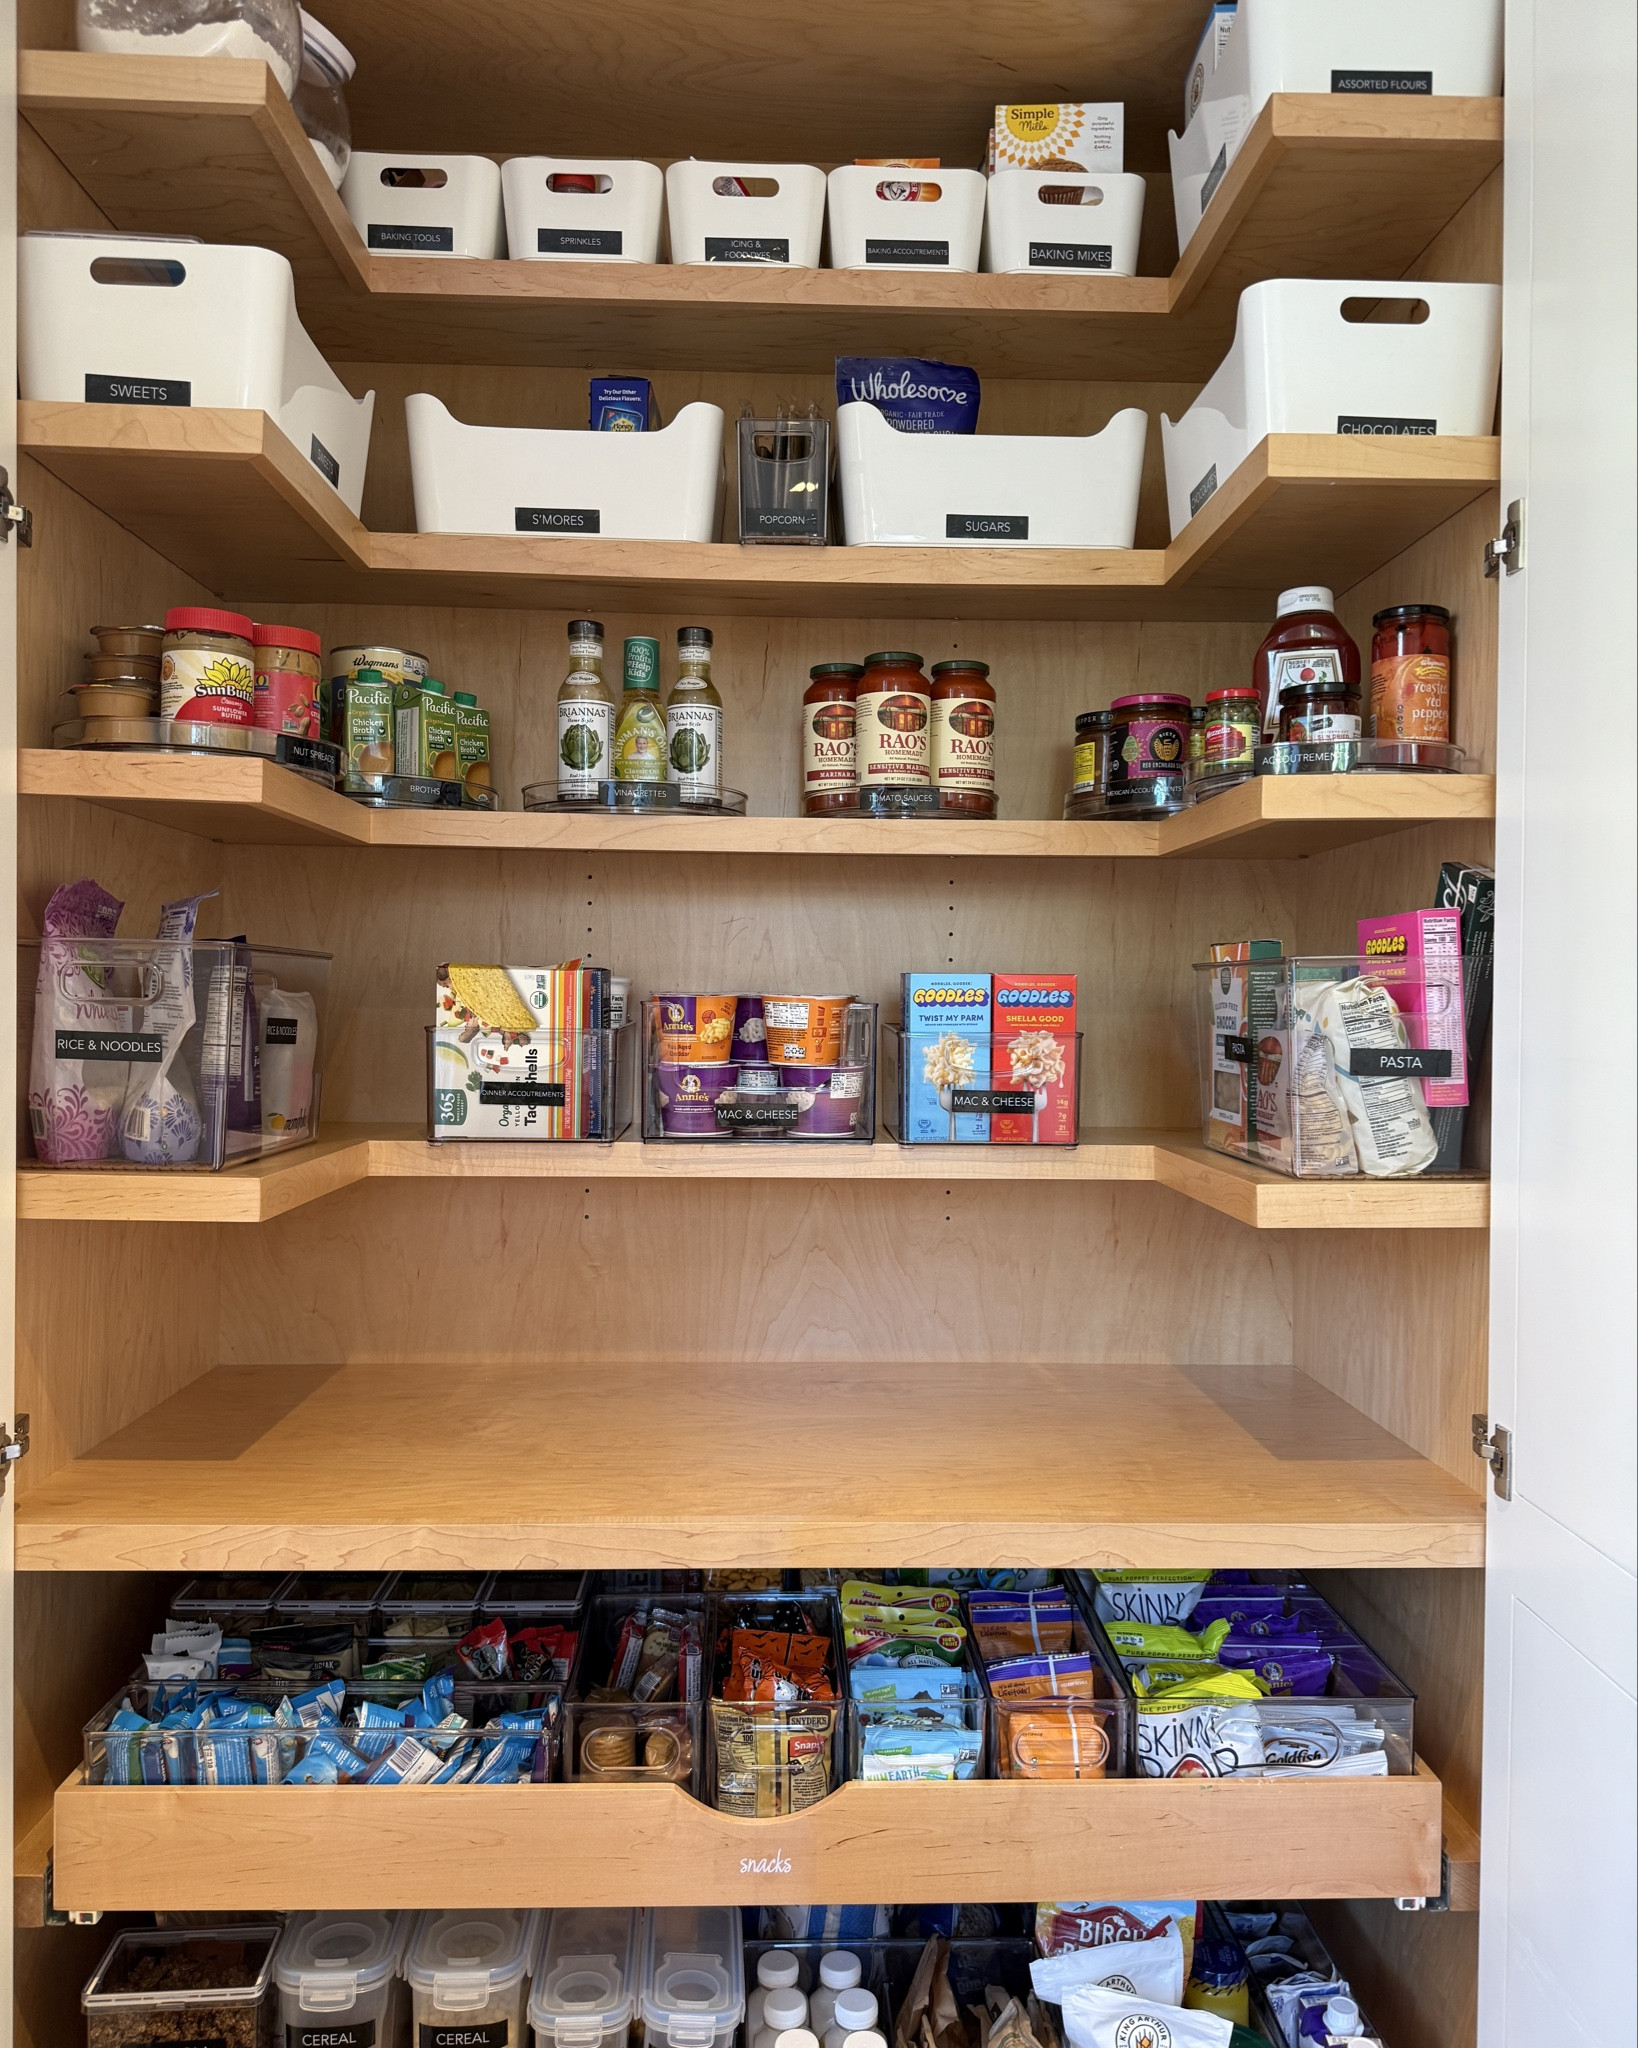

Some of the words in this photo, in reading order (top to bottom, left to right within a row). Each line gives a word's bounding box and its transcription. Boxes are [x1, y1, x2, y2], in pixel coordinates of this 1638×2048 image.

[1338, 79, 1389, 90] ASSORTED
[1390, 80, 1428, 91] FLOURS
[1010, 107, 1055, 121] Simple
[1018, 120, 1050, 132] Mills
[381, 231, 410, 243] BAKING
[412, 233, 441, 244] TOOLS
[559, 236, 602, 247] SPRINKLES
[731, 240, 754, 249] ICING
[755, 240, 762, 249] &
[724, 250, 748, 259] FOOD
[750, 251, 771, 260] DYES
[867, 247, 891, 256] BAKING
[892, 248, 948, 257] ACCOUTREMENTS
[1030, 248, 1075, 262] BAKING
[1077, 249, 1111, 263] MIXES
[109, 383, 168, 401] SWEETS
[851, 370, 969, 406] Wholesome
[908, 411, 923, 419] FAIR
[924, 411, 945, 419] TRADE
[611, 422, 634, 431] Honey
[886, 418, 935, 431] POWDERED
[1341, 423, 1436, 436] CHOCOLATES
[316, 447, 335, 476] SWEETS
[531, 513, 584, 528] S'MORES
[758, 514, 806, 526] POPCORN
[965, 520, 1012, 533] SUGARS
[630, 645, 650, 656] 100%
[352, 653, 400, 669] Wegmans
[627, 652, 652, 665] Profits
[631, 660, 651, 673] Help
[627, 668, 647, 678] Kids
[345, 687, 392, 706] Pacific
[1425, 696, 1441, 708] red
[212, 705, 249, 717] SUNFLOWER
[421, 695, 456, 716] Pacific
[220, 712, 243, 722] BUTTER
[455, 710, 490, 727] Pacific
[558, 706, 606, 719] BRIANNAS
[667, 710, 714, 722] BRIANNAS
[352, 718, 384, 727] Chicken
[352, 726, 375, 735] Broth
[428, 726, 452, 736] Chicken
[1158, 731, 1177, 740] SIETE
[428, 734, 445, 743] Broth
[459, 738, 484, 747] Chicken
[613, 726, 657, 761] NEWMAN'S
[878, 733, 928, 751] RAO'S
[459, 745, 477, 754] Broth
[884, 749, 924, 758] HOMEMADE
[949, 738, 994, 757] RAO'S
[293, 746, 309, 757] NUT
[309, 750, 336, 765] SPREADS
[955, 754, 993, 763] HOMEMADE
[1261, 750, 1351, 766] ACCOUTREMENTS
[624, 767, 648, 775] Classic
[869, 763, 905, 772] SENSITIVE
[939, 768, 974, 776] SENSITIVE
[819, 770, 857, 779] MARINARA
[409, 784, 441, 797] BROTHS
[1106, 788, 1130, 798] MEXICAN
[868, 793, 900, 803] TOMATO
[902, 794, 933, 803] SAUCES
[1365, 934, 1407, 956] GOODLES
[912, 987, 988, 1006] GOODLES
[996, 988, 1072, 1006] GOODLES
[1368, 994, 1386, 1005] Facts
[1214, 1002, 1228, 1012] GLUTEN
[1227, 1002, 1239, 1012] FREE
[918, 1014, 944, 1022] TWIST
[945, 1014, 960, 1022] MY
[960, 1014, 985, 1022] PARM
[1039, 1015, 1065, 1023] GOOD
[1216, 1015, 1238, 1031] GNOCCHI
[267, 1025, 276, 1036] RICE
[279, 1025, 297, 1037] NOODLES
[663, 1020, 695, 1032] Annie's
[1346, 1023, 1372, 1034] Calories
[1378, 1018, 1392, 1027] 200
[57, 1039, 85, 1051] RICE
[87, 1039, 98, 1051] &
[100, 1040, 162, 1054] NOODLES
[678, 1044, 692, 1052] Aged
[1231, 1042, 1246, 1056] PASTA
[1379, 1055, 1423, 1069] PASTA
[481, 1089, 508, 1098] DINNER
[507, 1089, 565, 1099] ACCOUTREMENTS
[675, 1092, 710, 1103] Annie's
[439, 1092, 457, 1123] 365
[953, 1096, 979, 1107] MAC
[981, 1096, 990, 1107] &
[992, 1096, 1035, 1108] CHEESE
[1056, 1099, 1069, 1107] 14g
[717, 1109, 743, 1120] MAC
[745, 1109, 754, 1120] &
[756, 1109, 798, 1121] CHEESE
[1057, 1113, 1067, 1121] 7g
[934, 1601, 950, 1611] FRUIT
[1112, 1587, 1187, 1626] SKINNY
[852, 1627, 897, 1639] MICKEY
[942, 1640, 958, 1648] FRUIT
[1126, 1649, 1146, 1657] PURE
[1156, 1703, 1187, 1713] POPPED
[739, 1716, 754, 1724] Facts
[790, 1716, 828, 1727] SNYDER'S
[742, 1734, 754, 1742] 100
[1265, 1750, 1322, 1764] Goldfish
[739, 1848, 792, 1874] snacks
[1119, 2017, 1136, 2042] KING
[1137, 2015, 1169, 2042] ARTHUR
[301, 2032, 357, 2048] CEREAL
[435, 2031, 491, 2047] CEREAL
